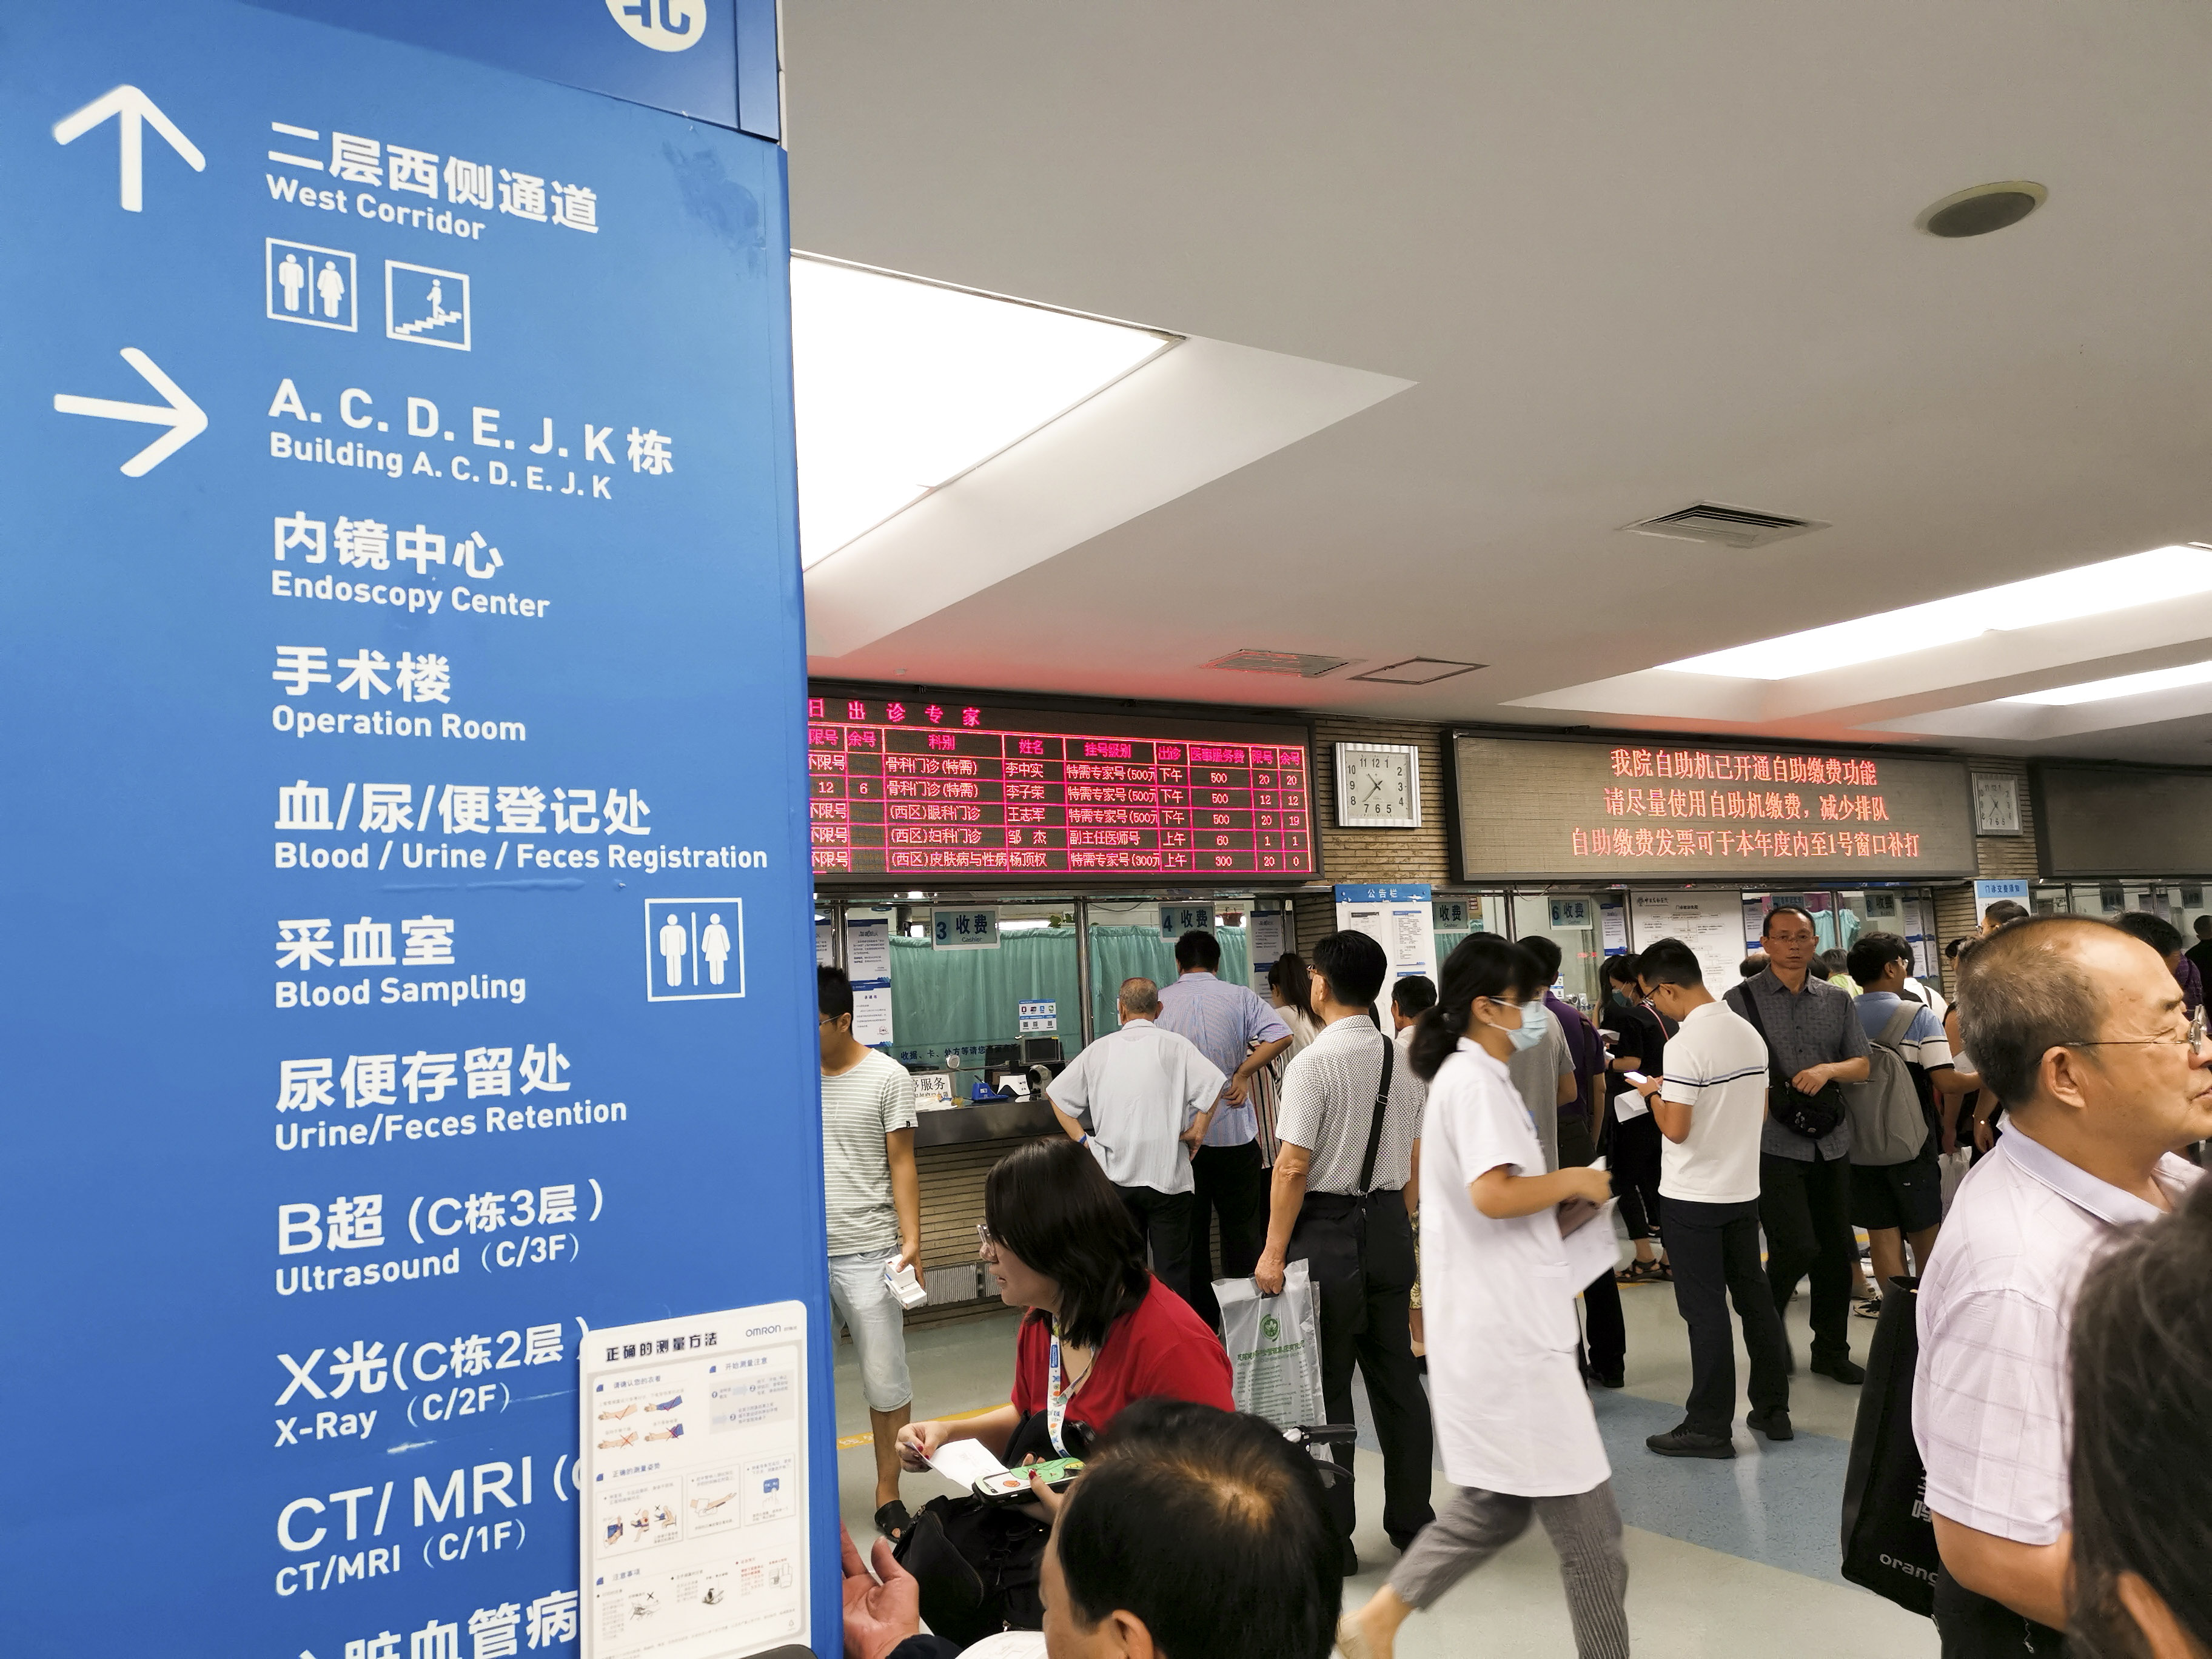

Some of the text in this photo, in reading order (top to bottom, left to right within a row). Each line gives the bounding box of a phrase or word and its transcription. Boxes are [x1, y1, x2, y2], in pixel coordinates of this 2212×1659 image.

[269, 122, 598, 233] 二层西侧通道
[266, 174, 485, 240] West Corridor
[271, 432, 403, 478] Building
[275, 511, 504, 578] 内镜中心
[272, 570, 550, 617] Endoscopy Center
[273, 646, 451, 703] 手术楼
[273, 705, 525, 740] Operation Room
[928, 734, 956, 751] 科别
[1019, 739, 1044, 755] 姓名
[886, 757, 977, 776] 骨科门诊(特需)
[1005, 763, 1044, 779] 李中实
[1159, 768, 1182, 783] 下午
[1210, 773, 1228, 783] 500
[1258, 775, 1270, 785] 20
[1286, 776, 1298, 786] 20
[1347, 765, 1356, 775] 10
[1359, 758, 1389, 768] 11 12 1
[1397, 766, 1403, 776] 2
[1610, 749, 1878, 786] 我院自助机已开通自助缴费功能
[819, 782, 834, 794] 12
[859, 783, 868, 794] 6
[887, 782, 979, 799] 骨科门诊(特需)
[1006, 785, 1045, 800] 李子荣
[1161, 789, 1184, 804] 下午
[1212, 794, 1229, 805] 500
[1260, 795, 1271, 805] 12
[1288, 796, 1299, 806] 12
[1349, 780, 1355, 790] 9
[1398, 782, 1403, 791] 3
[275, 780, 651, 835] 血/尿/便登记处
[1350, 796, 1356, 805] 8
[1364, 803, 1392, 814] 7 6 5
[1398, 797, 1404, 806] 4
[890, 805, 980, 821] (西区)眼科门诊
[1008, 807, 1045, 822] 王志军
[1162, 810, 1185, 825] 下午
[1213, 814, 1230, 825] 500
[1261, 816, 1272, 826] 20
[891, 829, 982, 845] (西区)妇科门诊
[1070, 831, 1141, 846] 副主任医师号
[1163, 831, 1186, 846] 上午
[1264, 836, 1271, 846] 1
[1292, 837, 1299, 847] 1
[1572, 827, 1920, 858] 自助缴费发票可于本年度内至1号窗口补打
[275, 842, 368, 868] Blood
[403, 843, 486, 868] Urine
[518, 843, 599, 868] Feces
[609, 845, 767, 873] Registration
[1164, 853, 1187, 867] 上午
[1264, 857, 1275, 867] 20
[1293, 857, 1299, 867] 0
[1367, 888, 1398, 899] 公告栏
[1163, 910, 1207, 932] 4 收费
[1440, 905, 1461, 922] 收费
[1552, 902, 1584, 920] 6 收费
[936, 915, 988, 940] 3 收费
[276, 915, 455, 970] 采血室
[276, 975, 525, 1008] Blood Sampling
[276, 1043, 570, 1113] 尿便存留处
[276, 1102, 626, 1150] Urine/Feces Retention
[276, 1234, 578, 1295] Ultrasound (C/3F)
[746, 1325, 782, 1338] OMRON
[606, 1332, 717, 1362] 正确的测量方法
[275, 1383, 509, 1448] X-Ray (C/2F)
[276, 1521, 525, 1595] CT/MRI (C/1F)
[300, 1590, 577, 1659] 血管病
